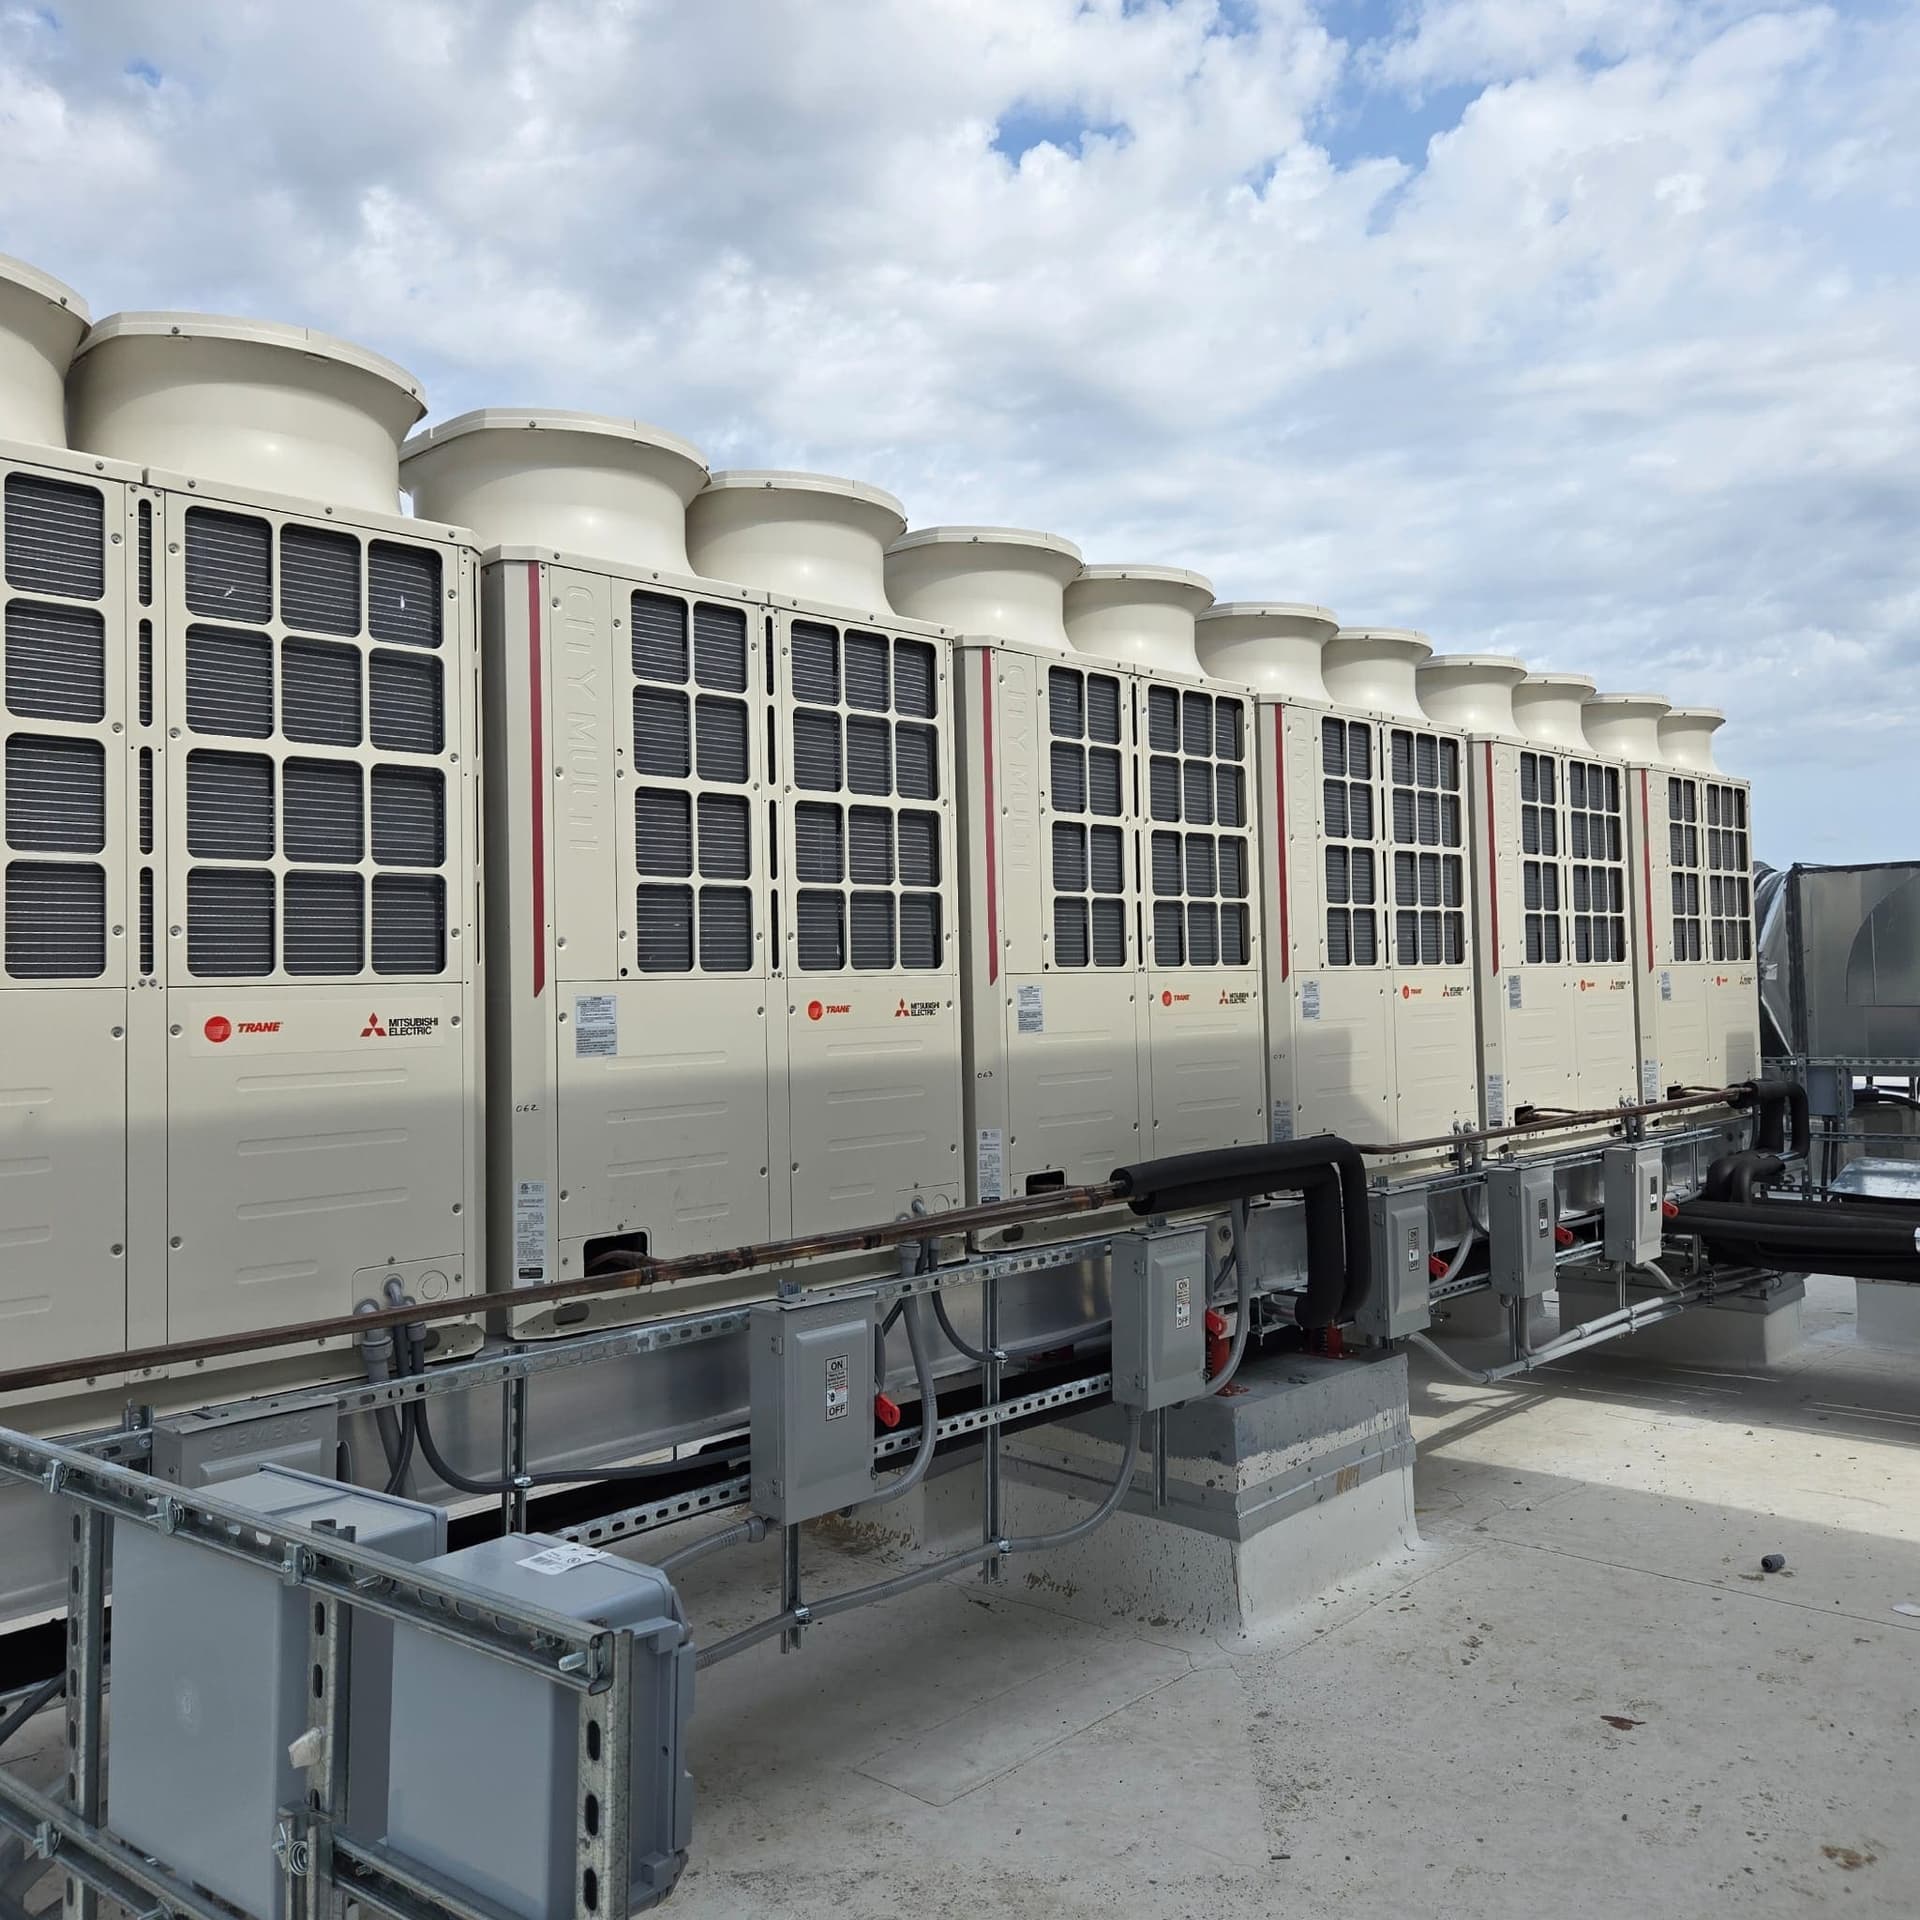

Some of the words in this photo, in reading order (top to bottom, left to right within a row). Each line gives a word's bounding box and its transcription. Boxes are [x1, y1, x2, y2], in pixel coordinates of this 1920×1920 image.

[826, 1004, 850, 1014] TRANE
[237, 1021, 282, 1033] TRANE
[388, 1017, 439, 1027] MITSUBISHI
[388, 1026, 432, 1036] ELECTRIC
[830, 1359, 843, 1371] ON
[828, 1404, 845, 1417] OFF
